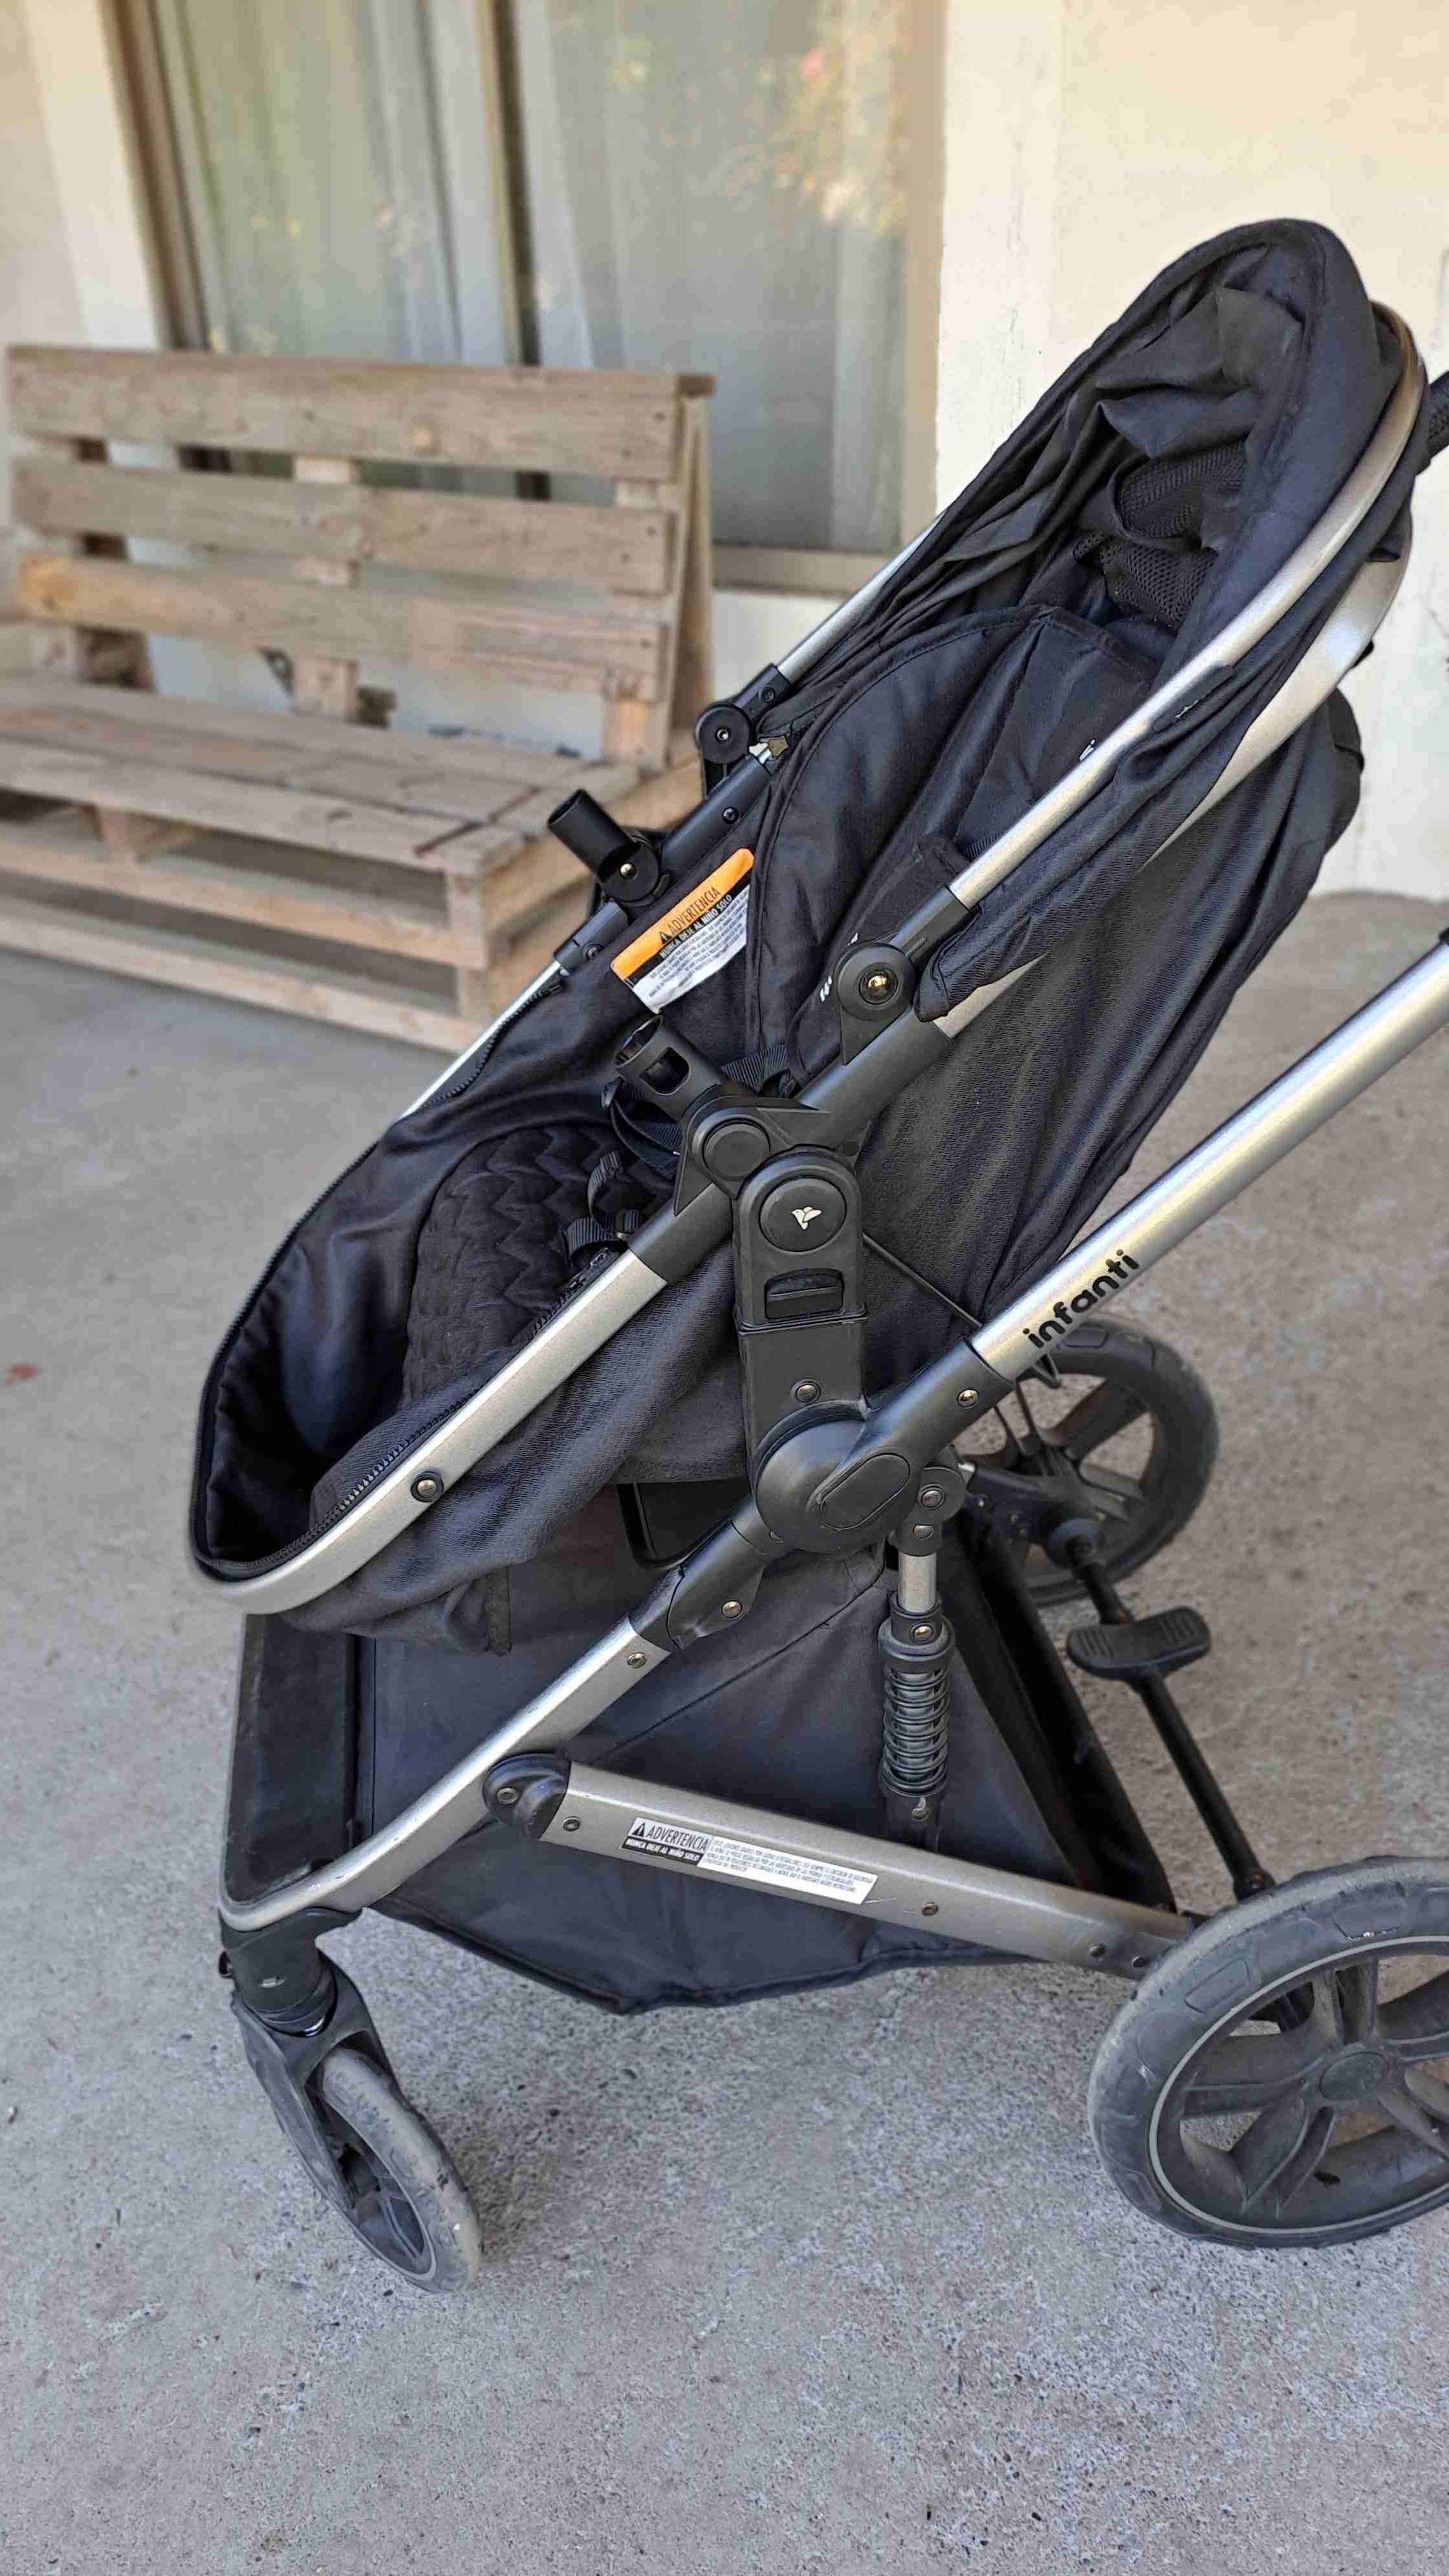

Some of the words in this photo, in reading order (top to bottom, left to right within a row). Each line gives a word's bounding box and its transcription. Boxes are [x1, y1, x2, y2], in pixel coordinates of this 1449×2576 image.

[659, 939, 681, 959] NUNCA
[680, 927, 695, 942] DEJE
[694, 922, 703, 932] AL
[716, 895, 733, 912] SOLO
[667, 886, 721, 936] ADVERTENCIA
[1023, 1249, 1140, 1348] infanti
[625, 1839, 646, 1850] NUNCA
[646, 1842, 660, 1852] DEJE
[659, 1846, 668, 1854] AL
[684, 1853, 701, 1861] SOLO
[647, 1825, 709, 1852] ADVERTENCIA
